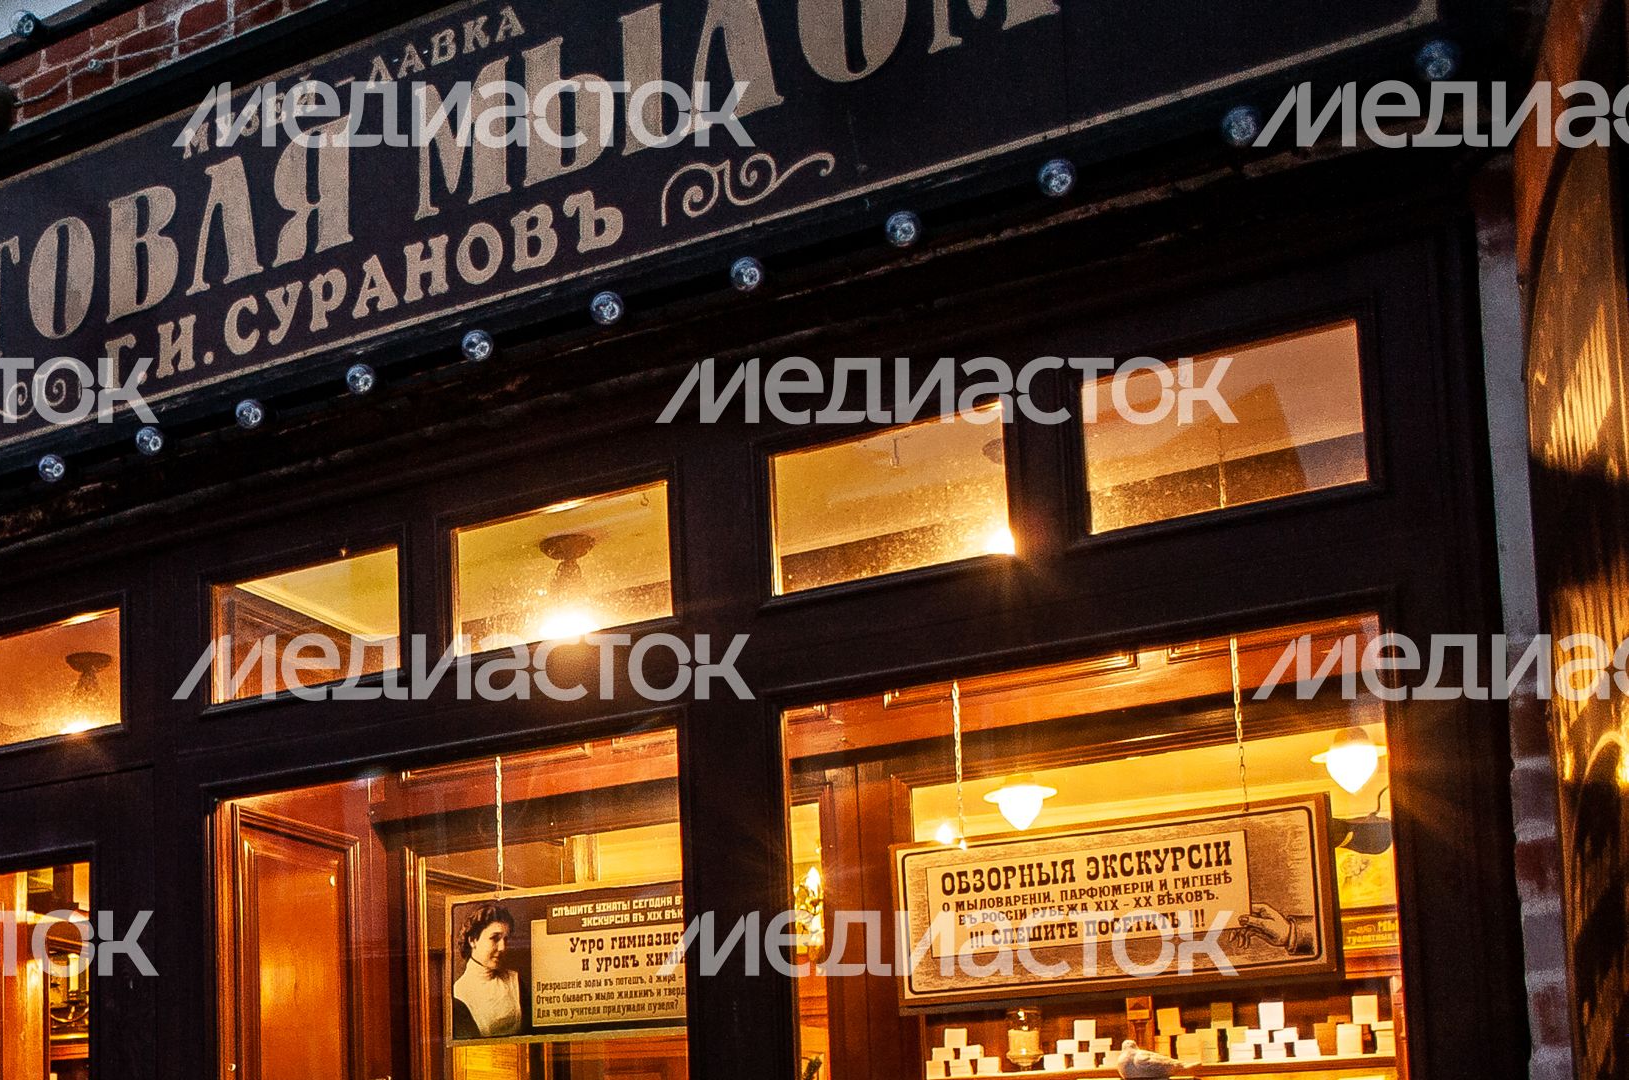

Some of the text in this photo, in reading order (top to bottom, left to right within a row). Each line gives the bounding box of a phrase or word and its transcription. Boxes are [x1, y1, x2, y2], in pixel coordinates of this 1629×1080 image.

[941, 840, 1232, 896] ОБЗОРНЫЯ ЭКСКУРСІИ
[632, 896, 672, 909] СЕГОДНЯ
[942, 902, 950, 912] О
[1060, 880, 1154, 901] ПАРФЮМЕРІИ
[1159, 879, 1168, 891] И
[632, 913, 645, 923] ВЪ
[959, 914, 977, 925] ВЪ
[982, 909, 1027, 923] РОССІИ
[1032, 902, 1088, 919] РУБЕЖА
[991, 922, 1078, 945] СПЕШИТЕ
[1085, 910, 1181, 937] ПОСЕТИТЬ
[1189, 909, 1205, 929] !!!
[569, 936, 604, 954] Утро
[582, 958, 590, 971] и
[596, 954, 639, 972] урокъ
[648, 975, 653, 983] а
[655, 974, 676, 984] жира
[536, 995, 560, 1005] Отчего
[562, 993, 593, 1003] бываетъ
[594, 991, 614, 1001] мыло
[617, 989, 654, 999] жидкимъ
[656, 988, 661, 996] и
[552, 1008, 568, 1017] чего
[602, 1003, 645, 1016] придумали
